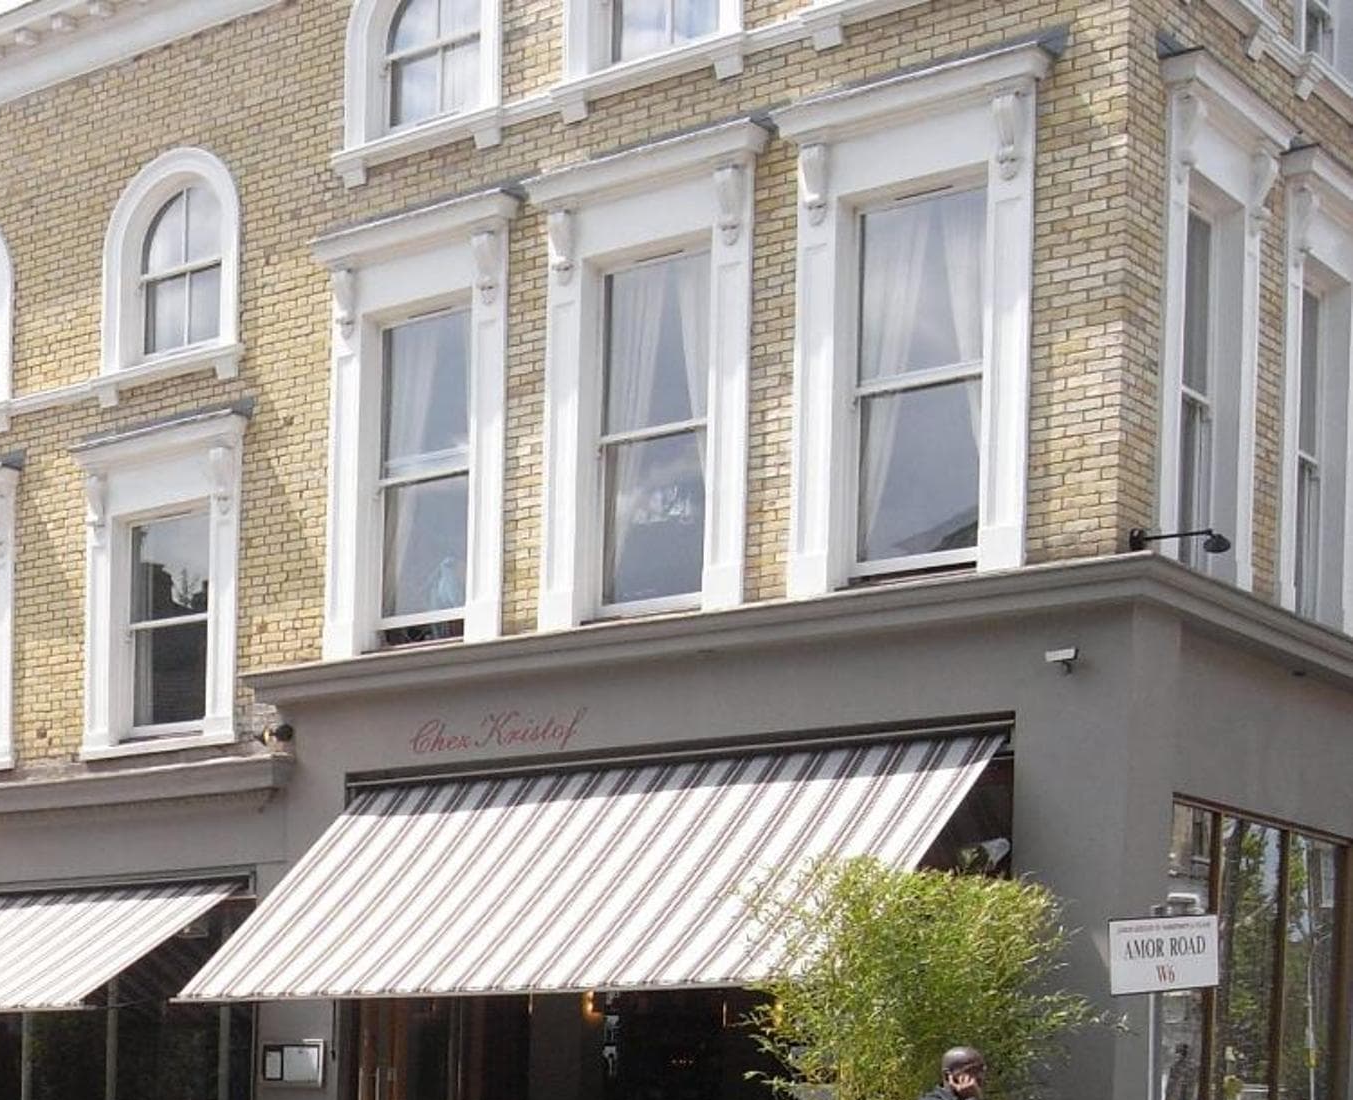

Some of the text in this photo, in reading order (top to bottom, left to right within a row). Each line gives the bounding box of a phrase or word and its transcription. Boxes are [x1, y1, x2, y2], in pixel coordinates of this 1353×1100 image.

[410, 706, 588, 754] Chez Kristof
[1125, 935, 1206, 959] AMOR ROAD
[1156, 964, 1175, 983] W6
